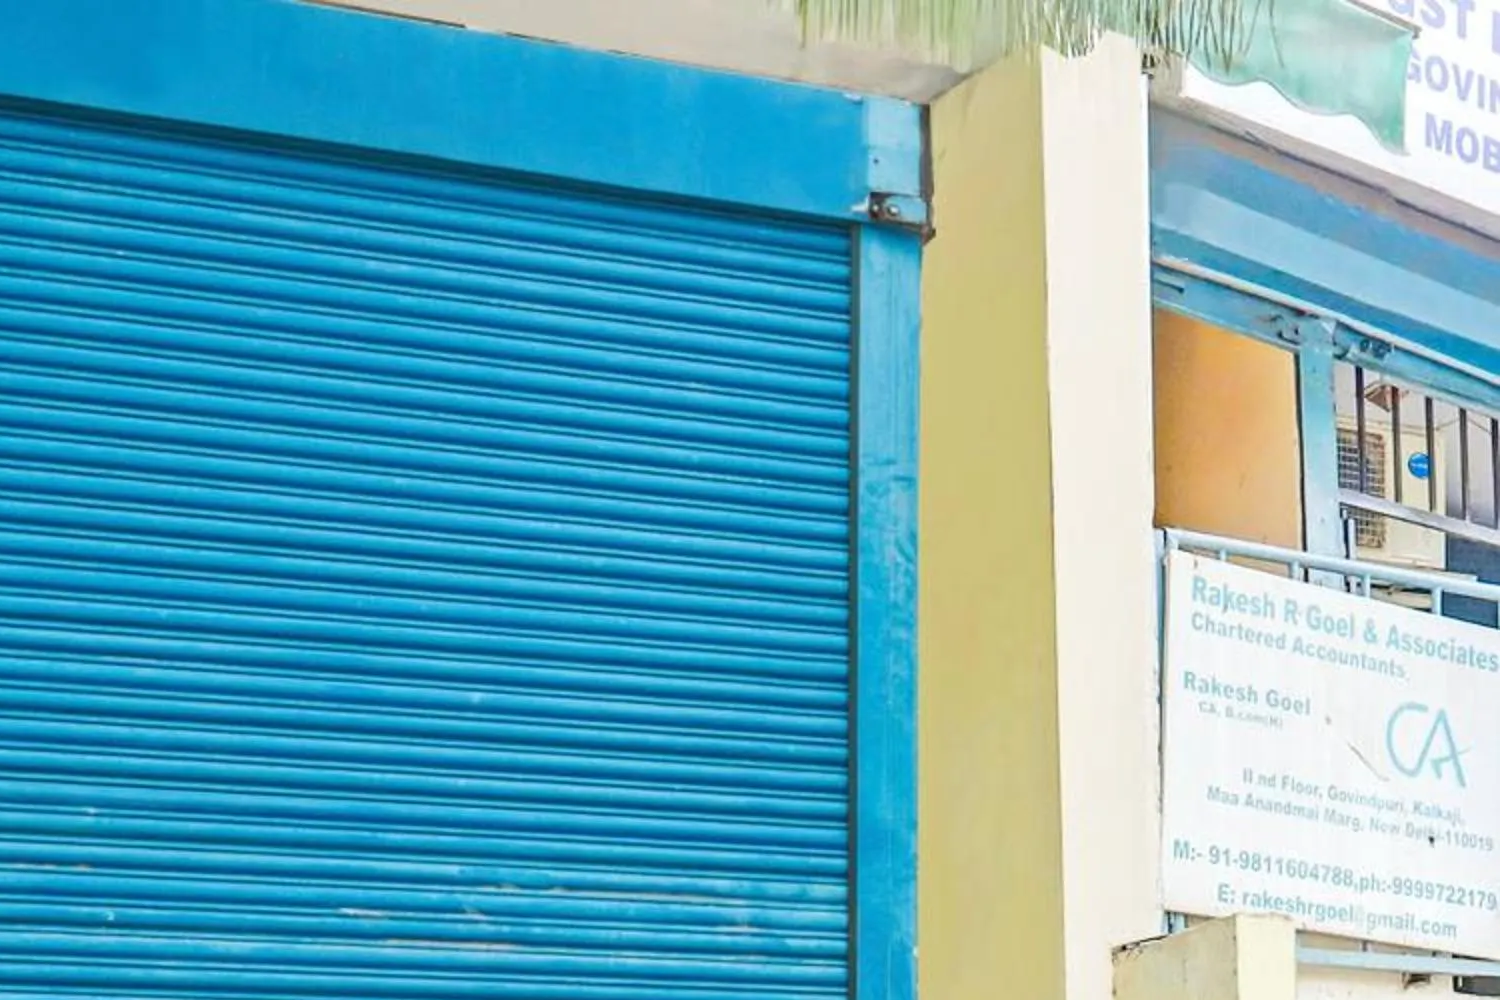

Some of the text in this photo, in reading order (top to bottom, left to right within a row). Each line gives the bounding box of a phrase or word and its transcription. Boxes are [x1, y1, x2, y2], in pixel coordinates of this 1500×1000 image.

[1191, 575, 1275, 619] Rakesh
[1306, 604, 1355, 640] Goel
[1363, 618, 1378, 645] &
[1385, 624, 1500, 673] Associates
[1191, 611, 1406, 679] Chartered Accountants
[1183, 670, 1311, 716] Rakesh Goel
[1207, 785, 1240, 805] Maa
[1370, 817, 1401, 835] New
[1281, 775, 1324, 799] Floor,
[1217, 883, 1236, 905] E:
